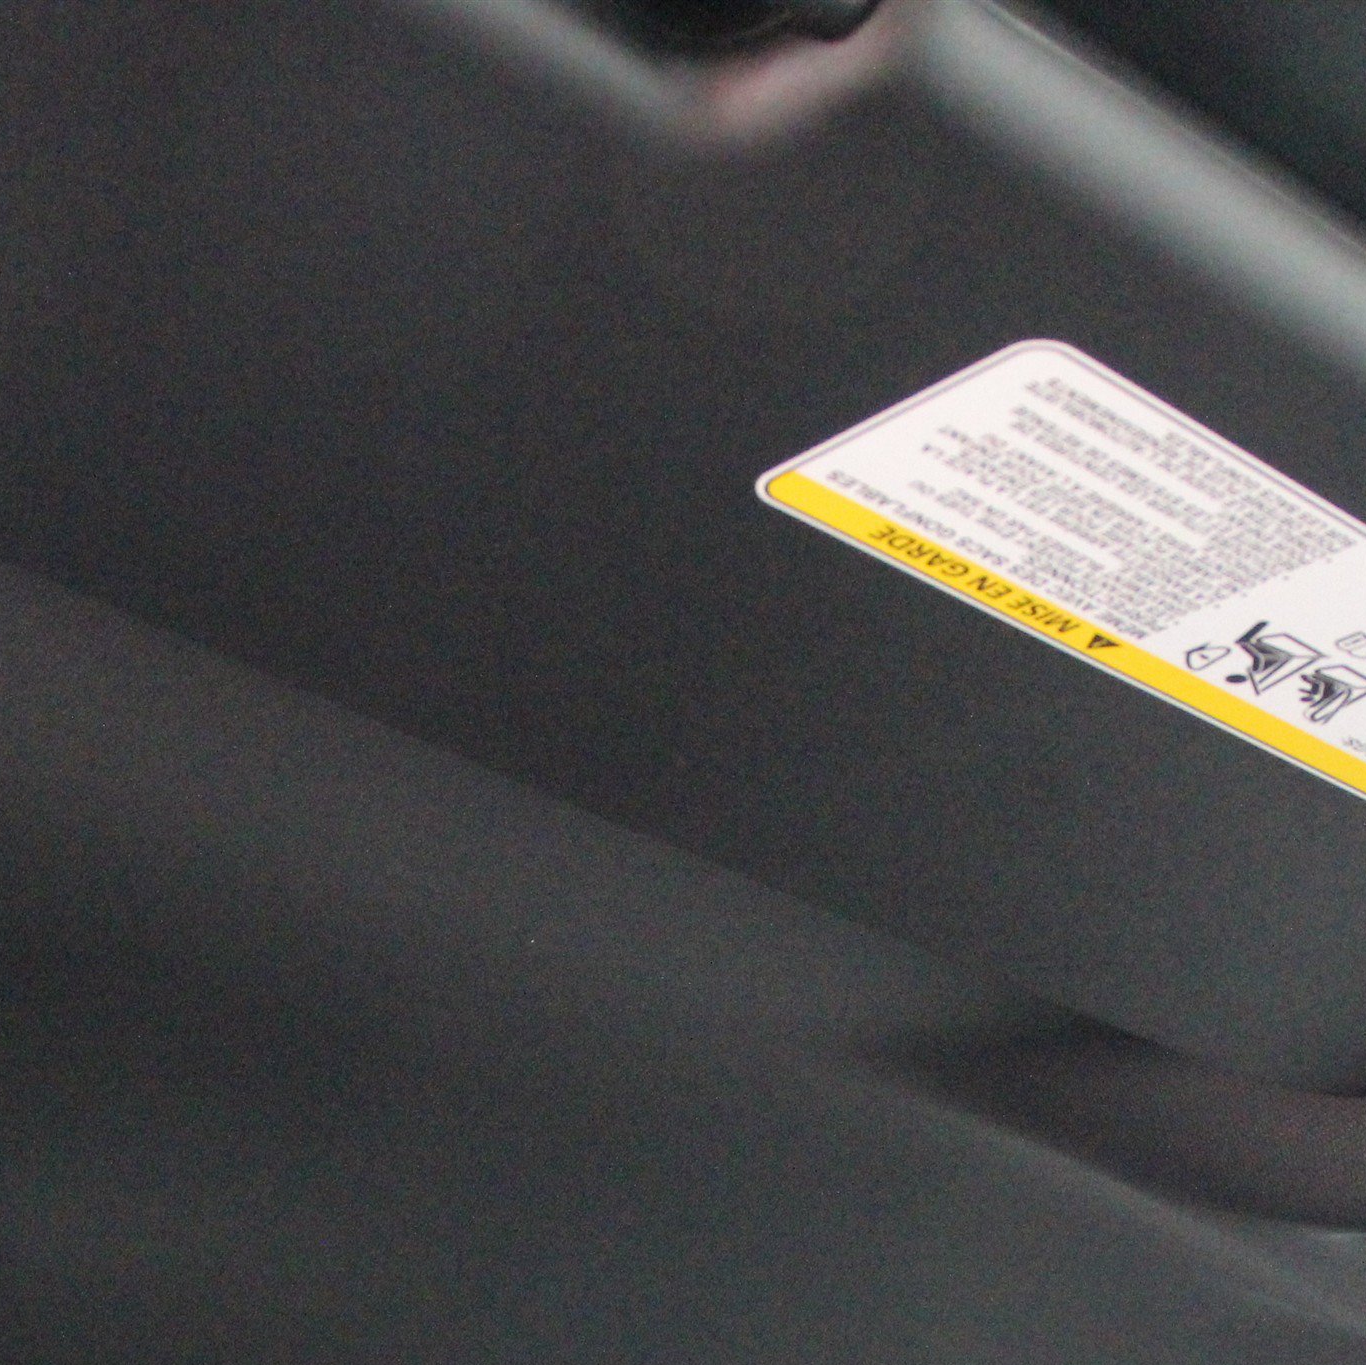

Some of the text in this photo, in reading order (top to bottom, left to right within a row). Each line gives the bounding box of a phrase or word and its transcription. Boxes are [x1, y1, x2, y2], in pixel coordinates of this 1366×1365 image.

[867, 525, 1081, 632] MISE EN GARDE
